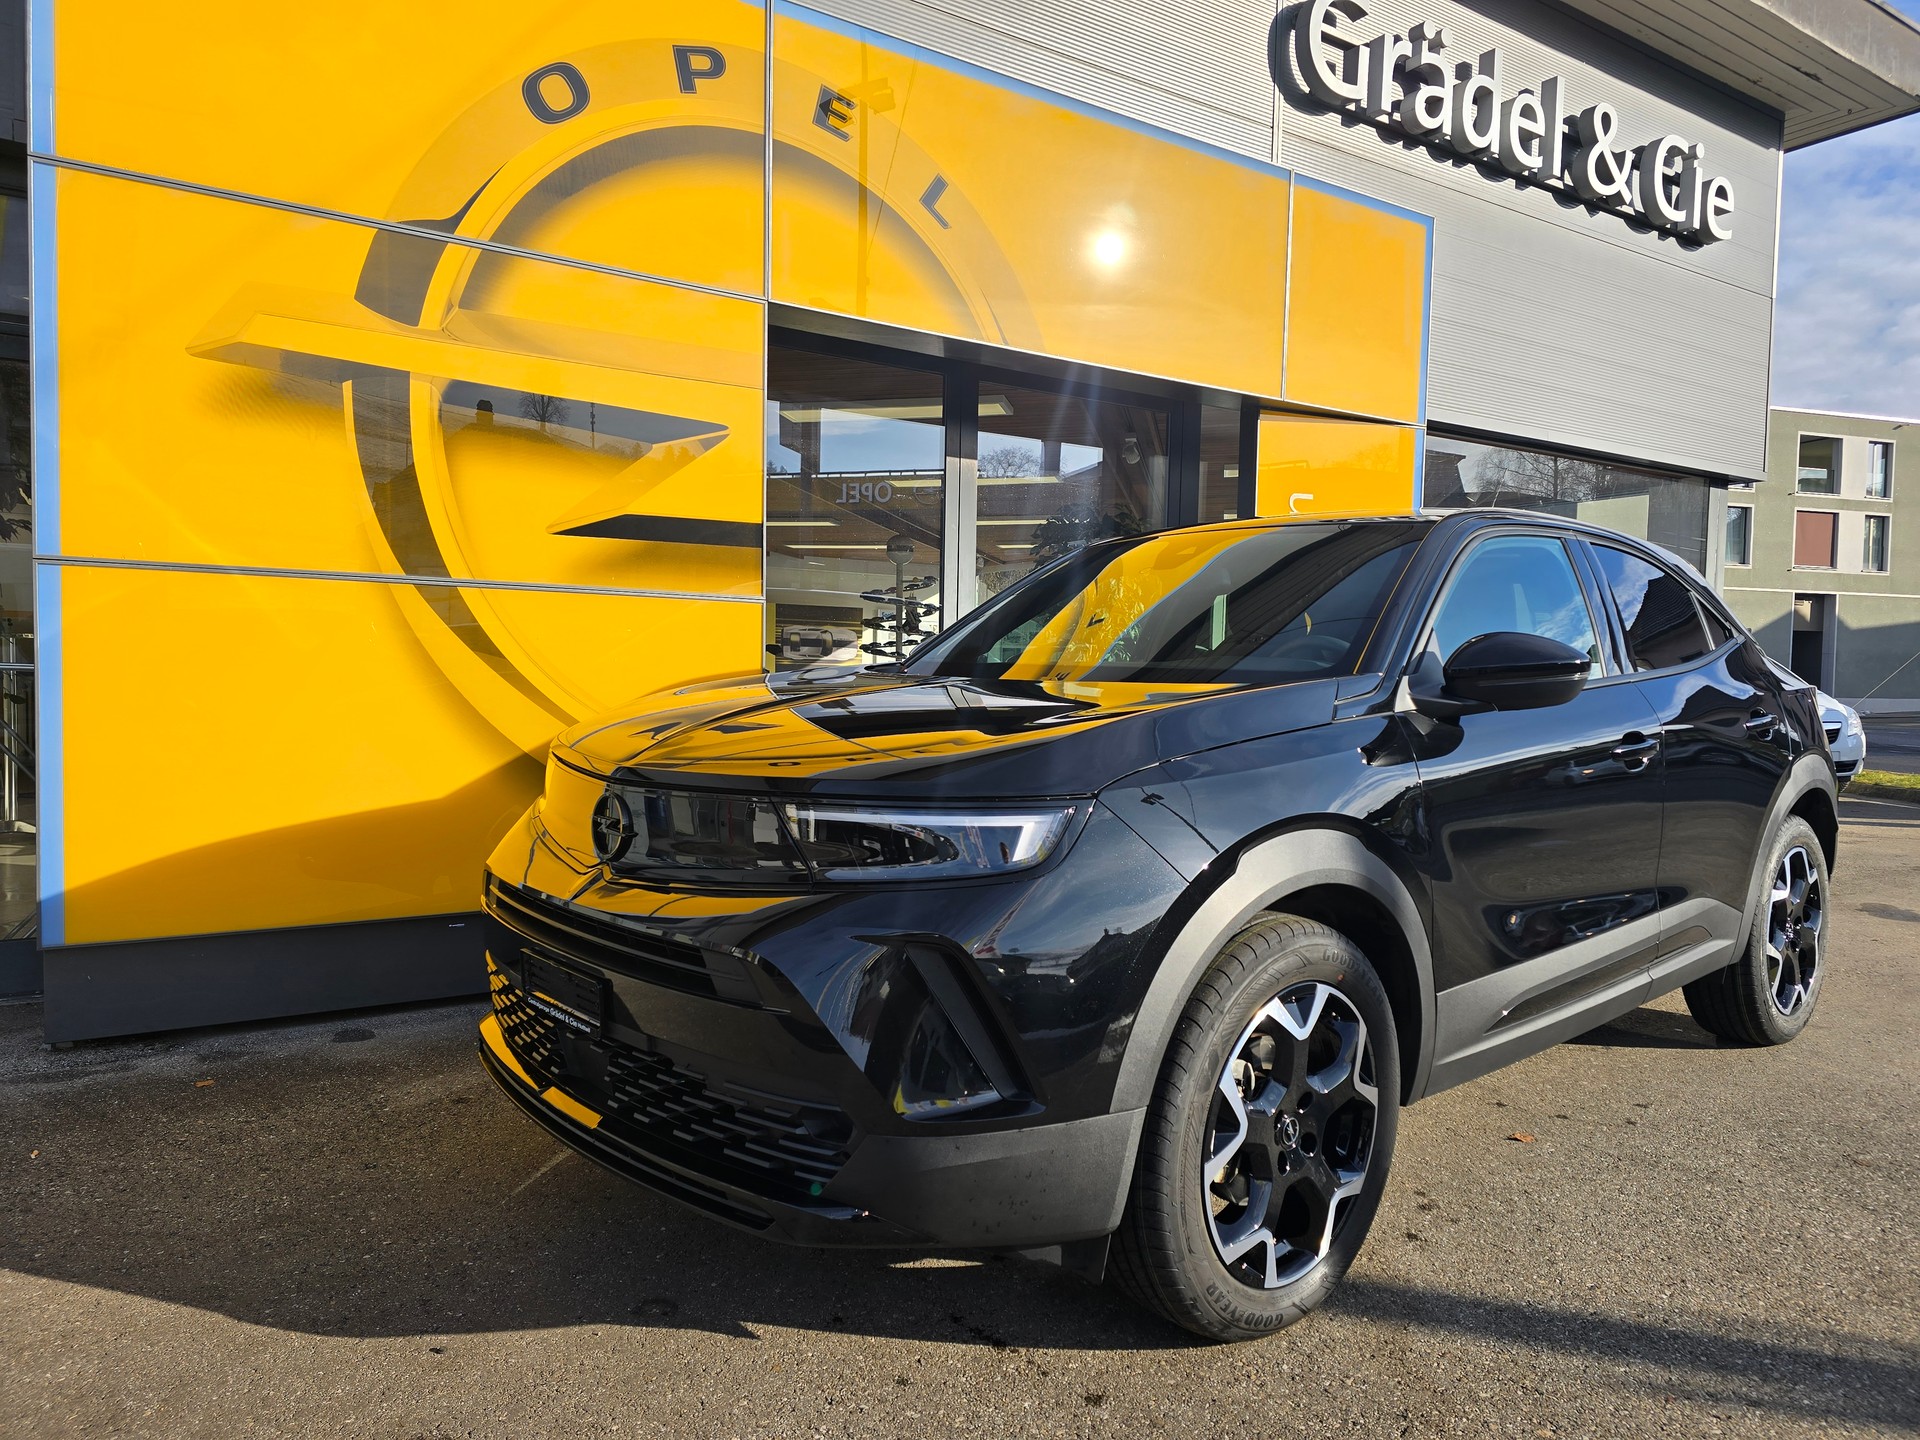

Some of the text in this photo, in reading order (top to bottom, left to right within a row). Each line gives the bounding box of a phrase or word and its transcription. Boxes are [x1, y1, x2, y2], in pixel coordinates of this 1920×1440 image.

[521, 44, 952, 230] OPEL
[1297, 0, 1735, 244] Grädel & Cie
[1206, 1282, 1284, 1329] GOODYEAR
